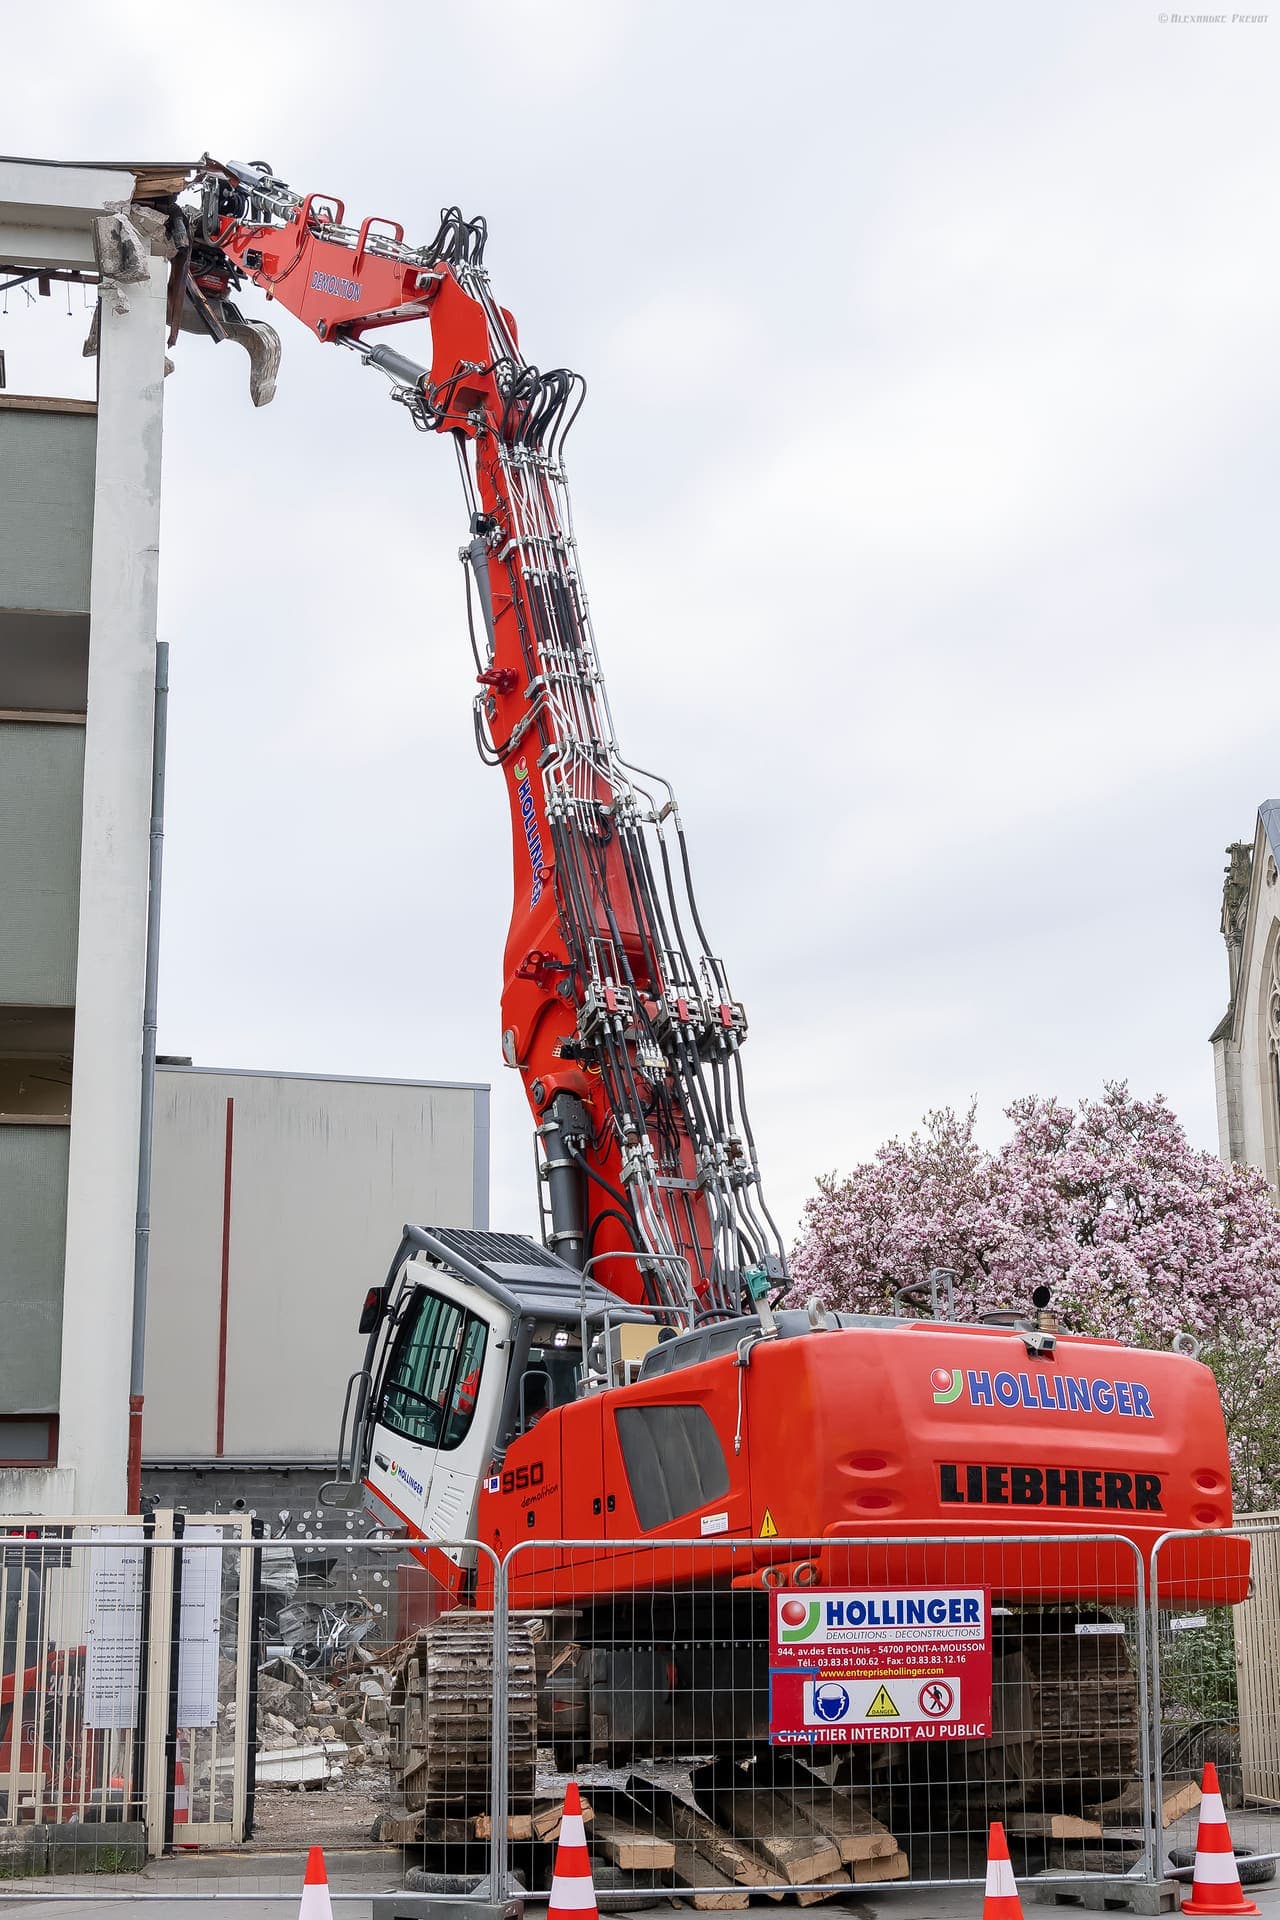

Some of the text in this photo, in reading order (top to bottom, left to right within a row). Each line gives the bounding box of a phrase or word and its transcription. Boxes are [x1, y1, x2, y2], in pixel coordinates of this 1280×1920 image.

[311, 270, 363, 302] DEMOLITION
[966, 1369, 1154, 1418] HOLLINGER
[397, 1466, 423, 1496] HOLLINGER
[502, 1462, 544, 1495] 950
[940, 1464, 1163, 1511] LIEBHERR
[520, 1484, 559, 1508] demolition
[826, 1598, 980, 1626] HOLLINGER
[826, 1631, 887, 1640] DEMOLITIONS
[895, 1628, 981, 1639] DECONSTRUCTIONS
[777, 1647, 795, 1657] 944,
[827, 1646, 870, 1655] Etats-Unis
[878, 1645, 904, 1653] 54700
[905, 1643, 985, 1653] PONT-A-MOUSSON
[818, 1657, 879, 1667] 03.83.81.00.62
[887, 1656, 904, 1665] Fax:
[906, 1655, 966, 1664] 03.83.83.12.16
[820, 1667, 944, 1678] www.entreprisehollinger.com
[778, 1723, 985, 1742] CHANTIER INTERDIT AU PUBLIC
